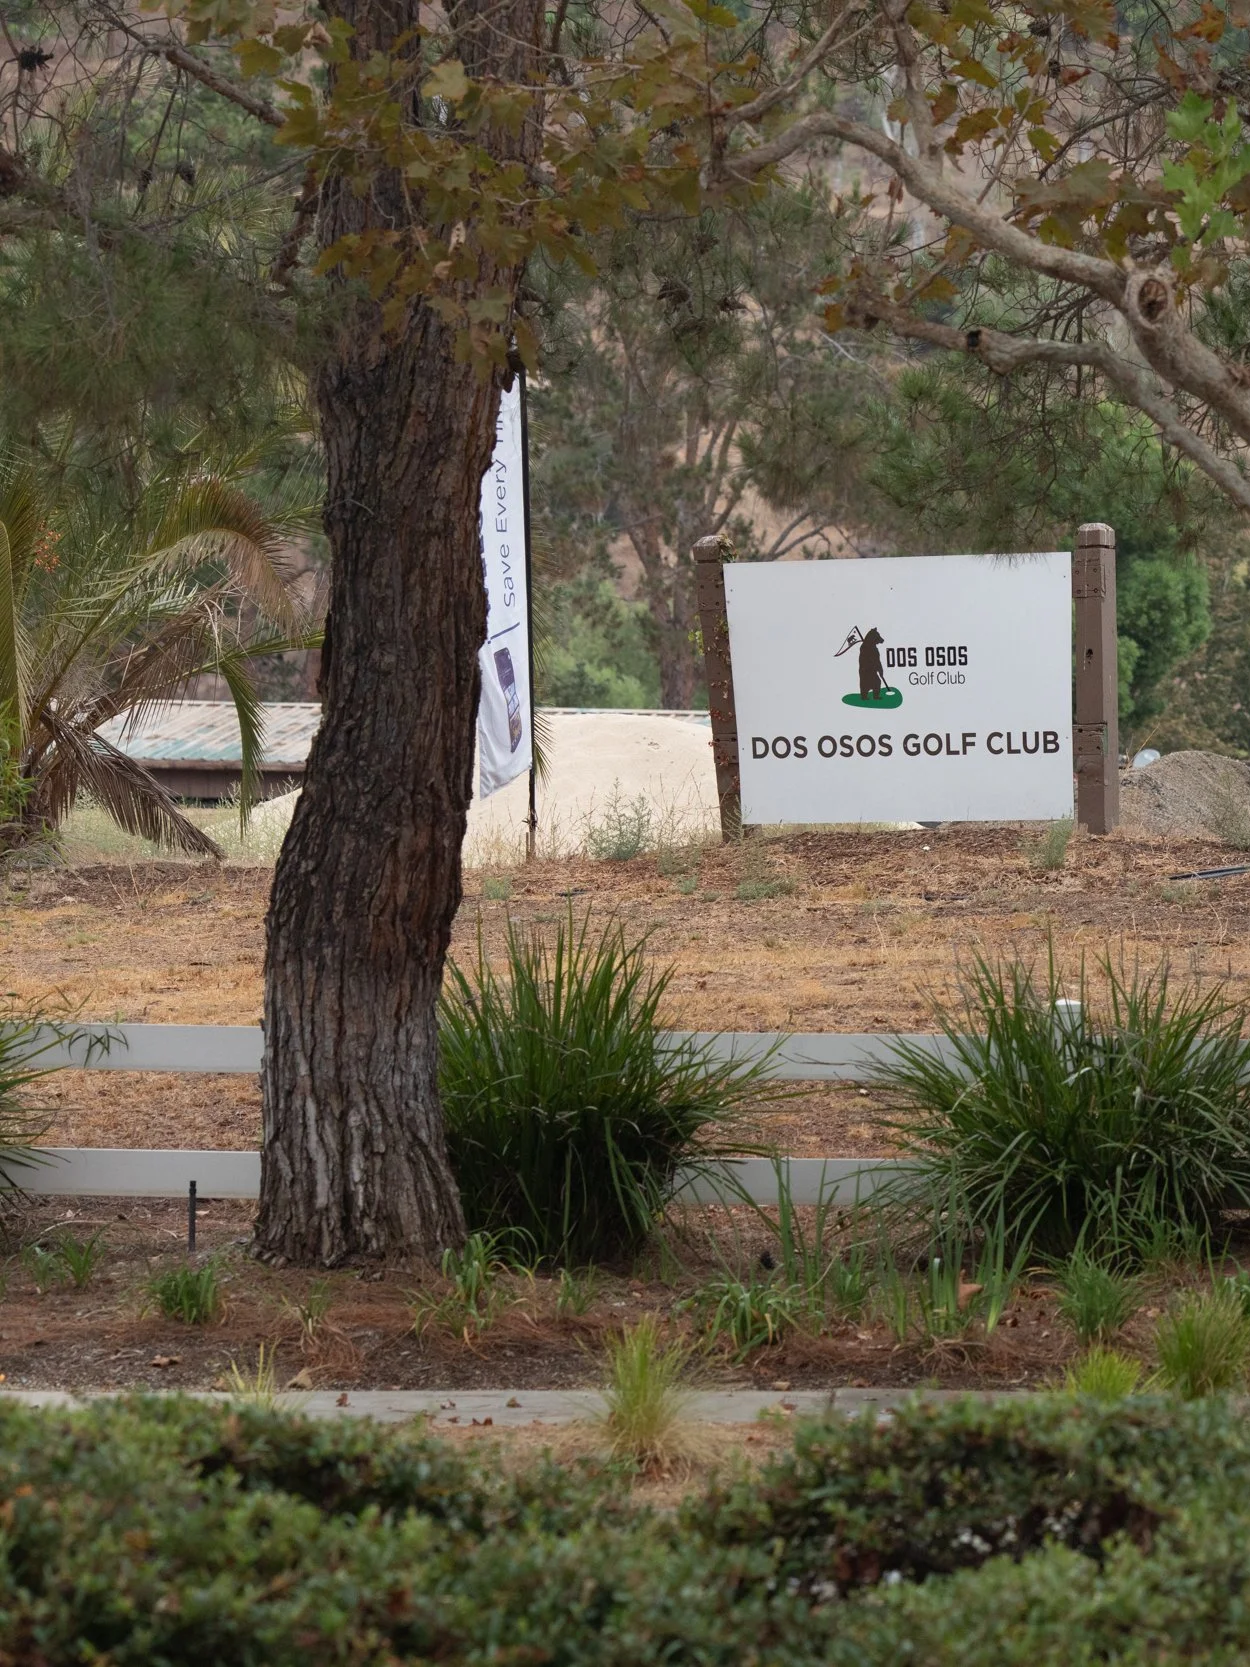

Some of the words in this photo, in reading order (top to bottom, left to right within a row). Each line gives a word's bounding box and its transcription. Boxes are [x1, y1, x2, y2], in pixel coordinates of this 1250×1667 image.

[495, 459, 508, 533] Every
[499, 543, 516, 608] Save
[886, 647, 917, 668] DOS
[925, 646, 968, 667] OSOS
[908, 671, 934, 686] Golf
[936, 671, 966, 685] Club
[751, 735, 808, 759] DOS
[817, 734, 893, 758] OSOS
[902, 732, 977, 757] GOLF
[986, 730, 1060, 755] CLUB
